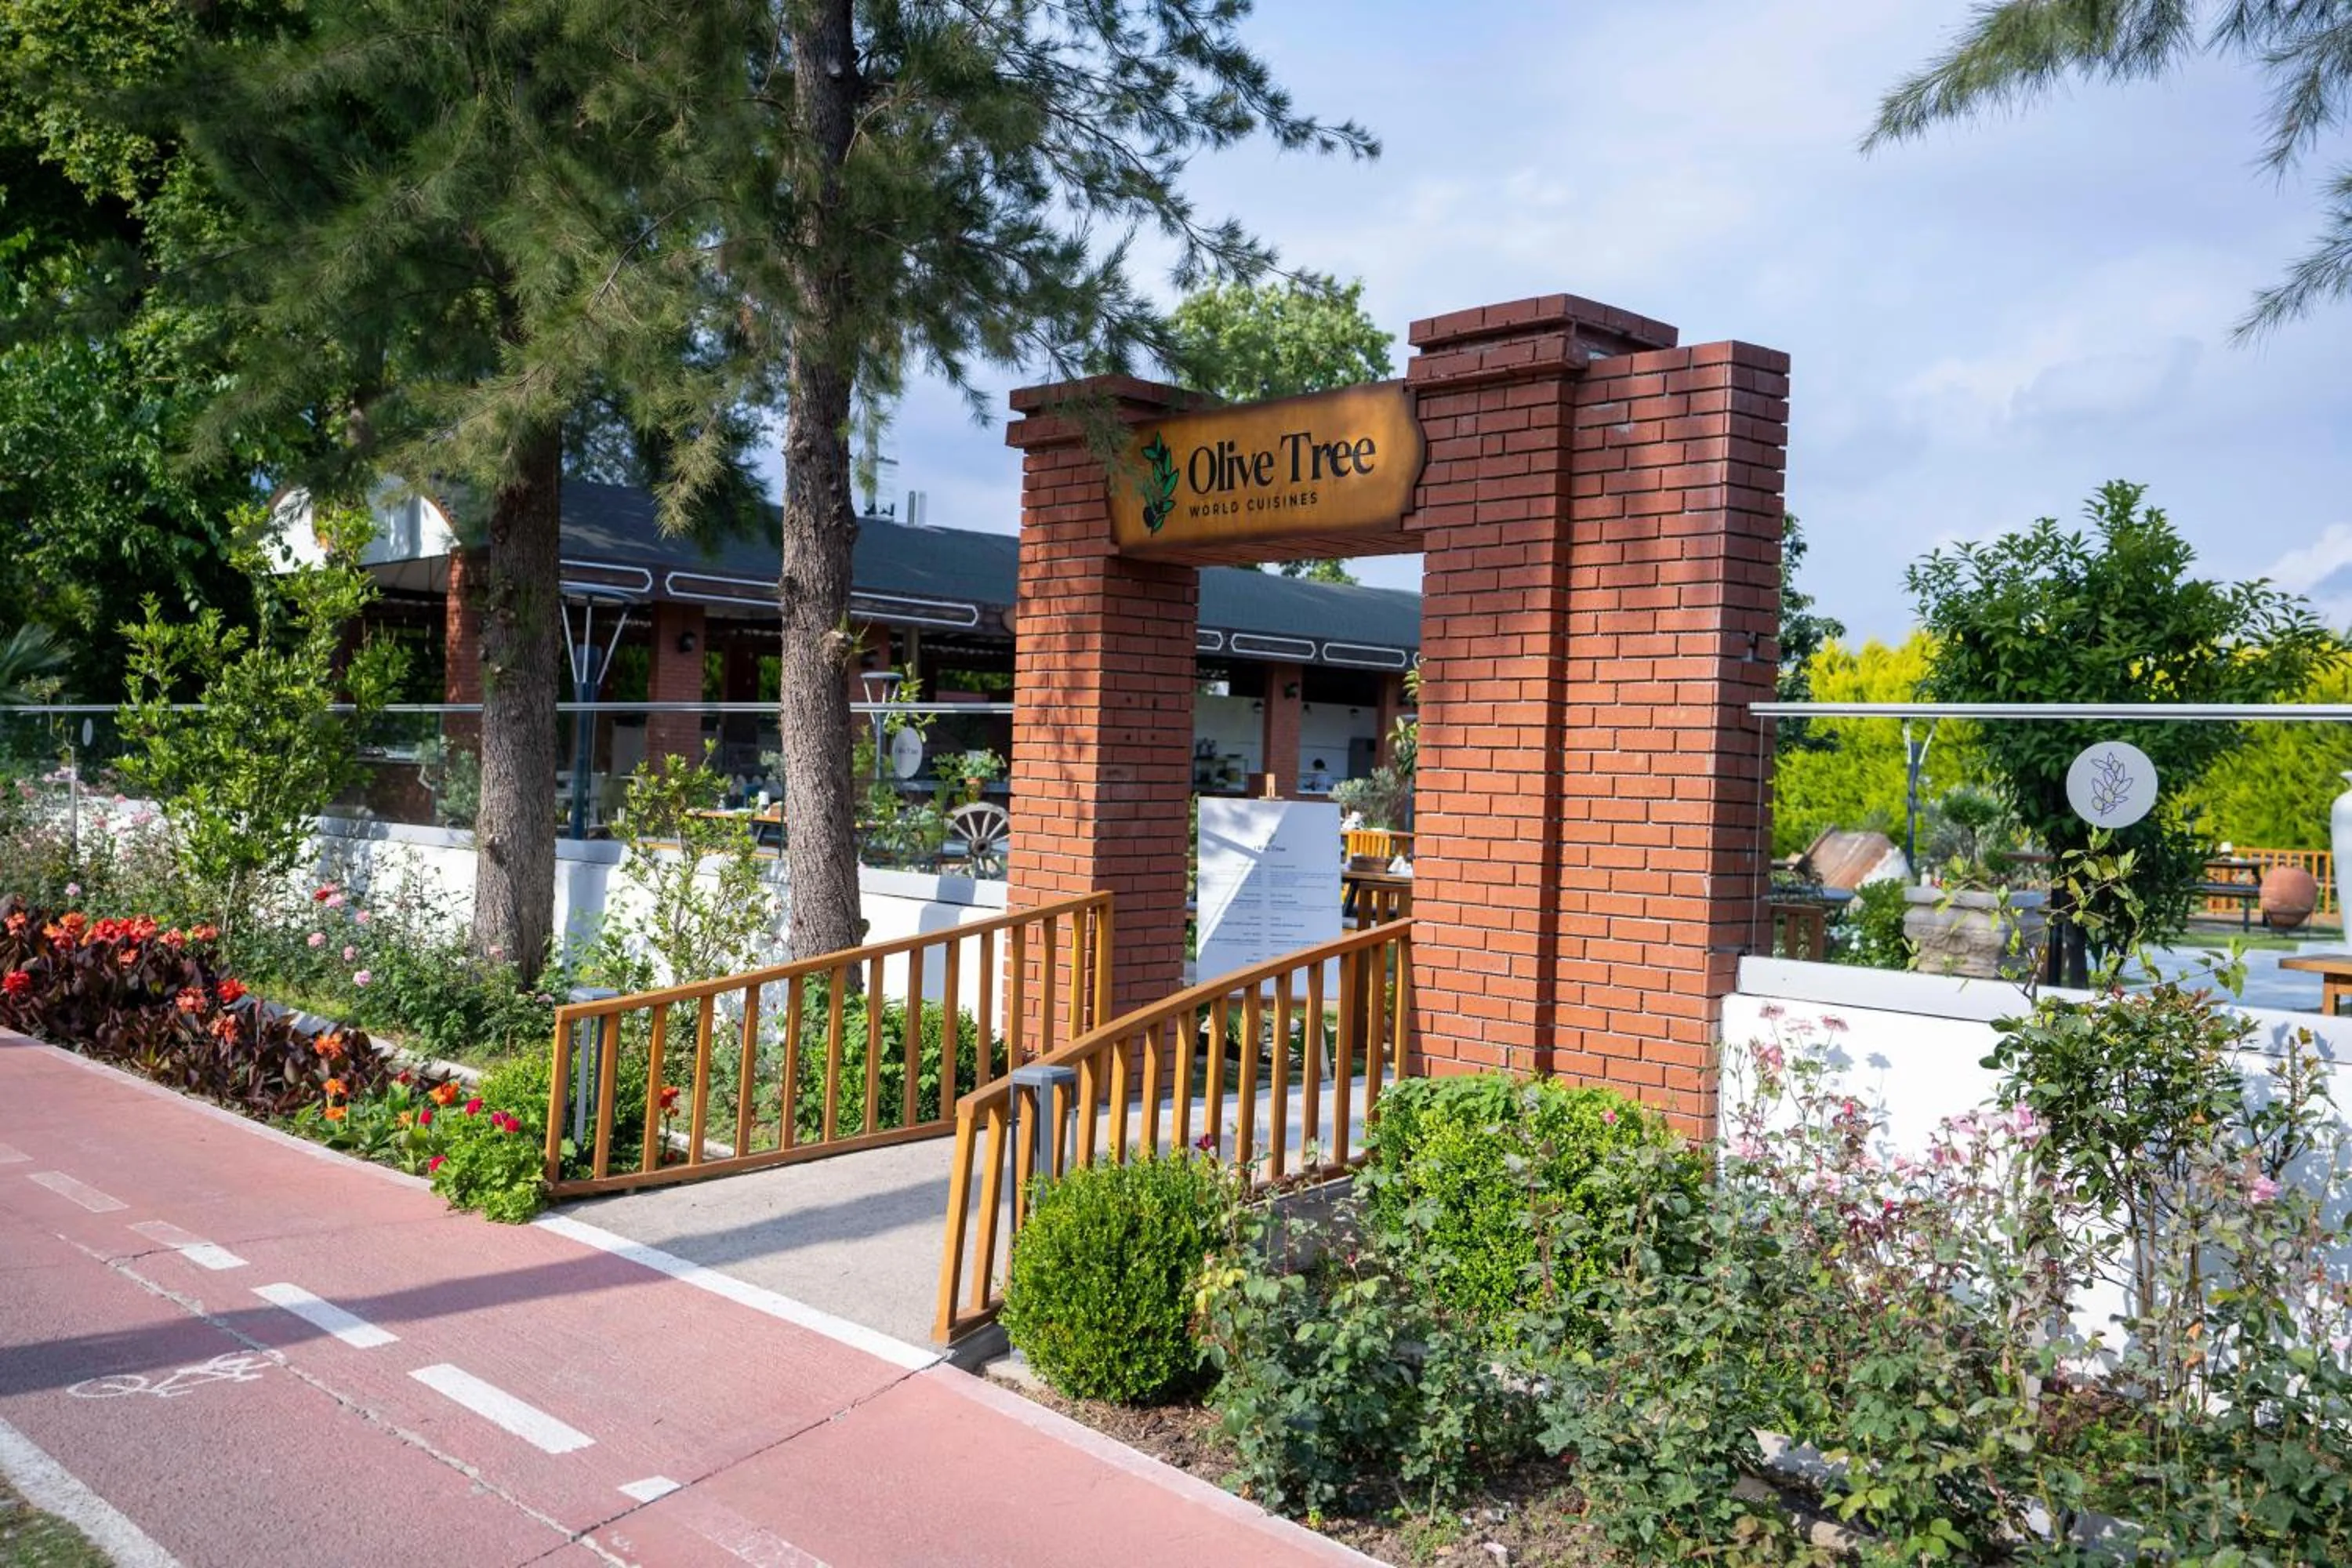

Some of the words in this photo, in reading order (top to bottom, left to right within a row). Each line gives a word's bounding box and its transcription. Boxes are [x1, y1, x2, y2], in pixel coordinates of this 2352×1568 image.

[1189, 441, 1274, 495] Olive
[1280, 432, 1377, 482] Tree
[1189, 501, 1240, 517] WORLD
[1247, 492, 1318, 511] CUISINES
